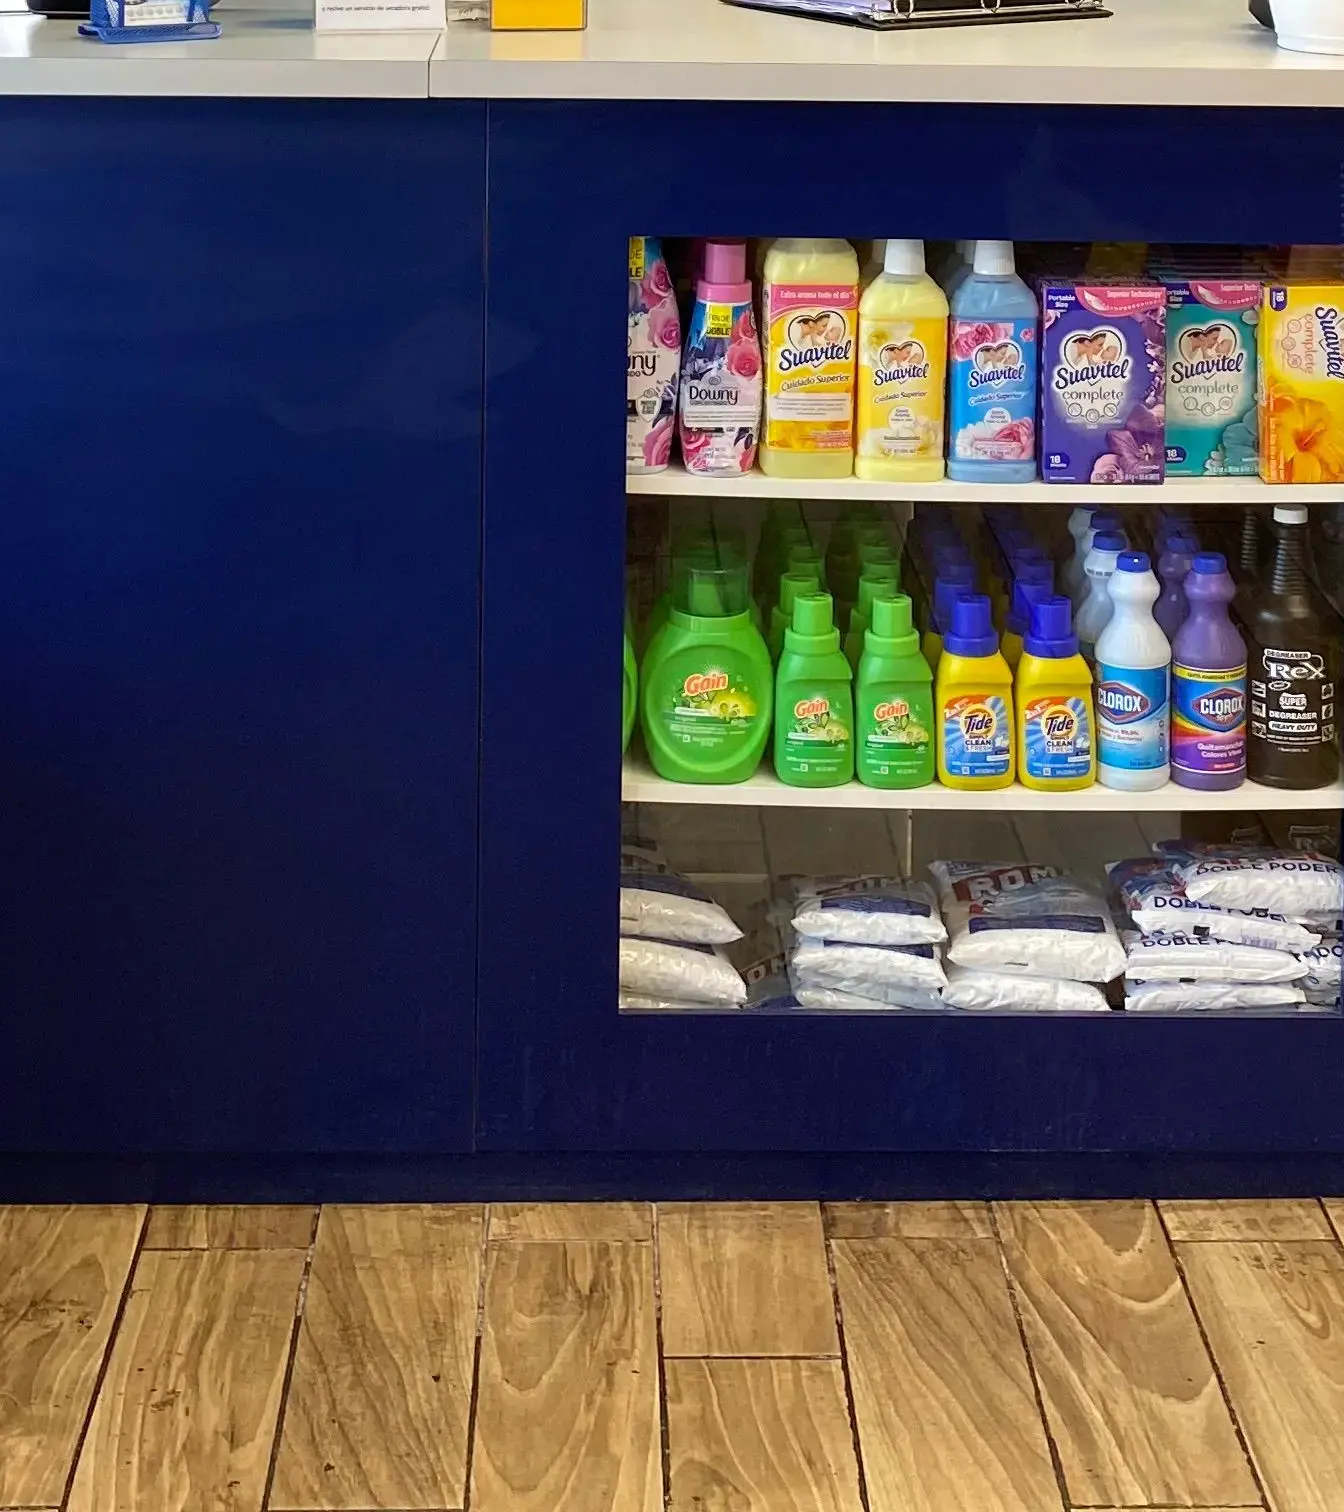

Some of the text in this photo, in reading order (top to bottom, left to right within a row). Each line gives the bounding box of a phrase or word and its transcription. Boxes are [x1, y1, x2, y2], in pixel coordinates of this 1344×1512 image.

[779, 340, 851, 371] Suavitel
[874, 364, 929, 385] Suavitel
[970, 364, 1025, 387] Suavitel
[1055, 359, 1129, 389] Suavitel
[1171, 352, 1243, 384] Suavitel
[782, 374, 850, 391] Cuidado Superior
[1178, 380, 1239, 396] complete
[689, 386, 738, 405] Downy
[1063, 387, 1123, 403] complete
[1267, 650, 1309, 658] DEGREASER
[686, 675, 727, 695] Gain
[796, 700, 828, 718] Gain
[1098, 688, 1141, 712] CLOROX
[1200, 696, 1244, 715] CLOROX
[1280, 697, 1307, 706] SUPER
[875, 702, 908, 720] Gain
[1269, 710, 1317, 720] DEGREASER
[965, 715, 992, 734] Tide
[1046, 715, 1074, 736] Tide
[1269, 862, 1338, 873] PODER
